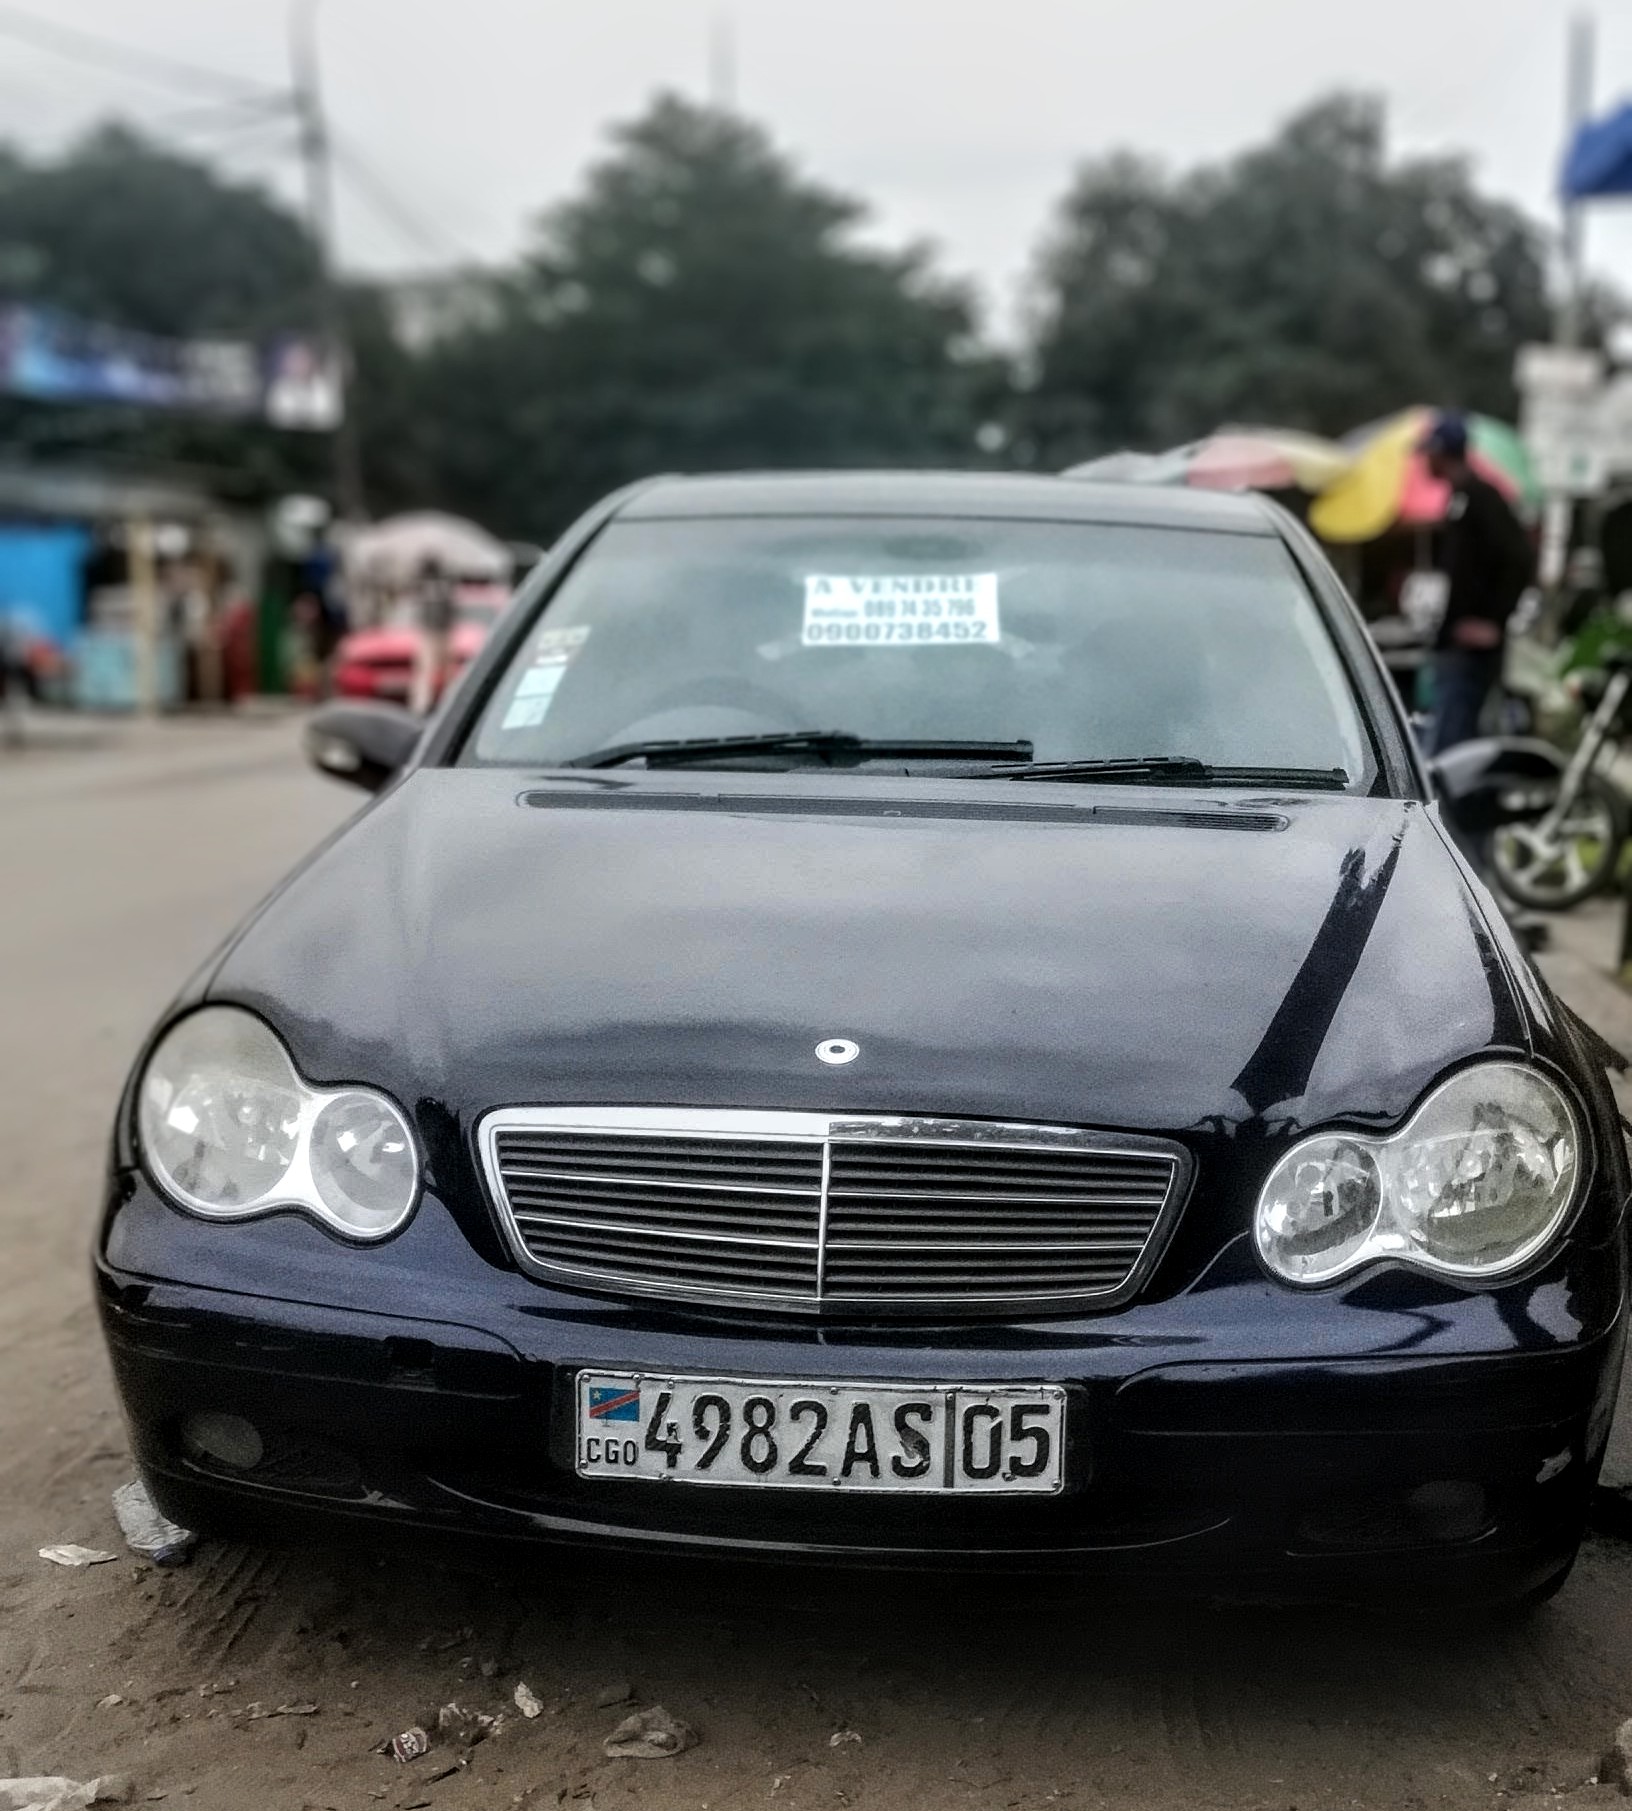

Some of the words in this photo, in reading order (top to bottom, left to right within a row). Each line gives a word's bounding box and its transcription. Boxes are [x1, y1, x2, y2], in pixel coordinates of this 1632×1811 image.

[586, 1437, 638, 1466] CGO
[645, 1391, 933, 1478] 4982AS
[962, 1403, 1050, 1479] 05
